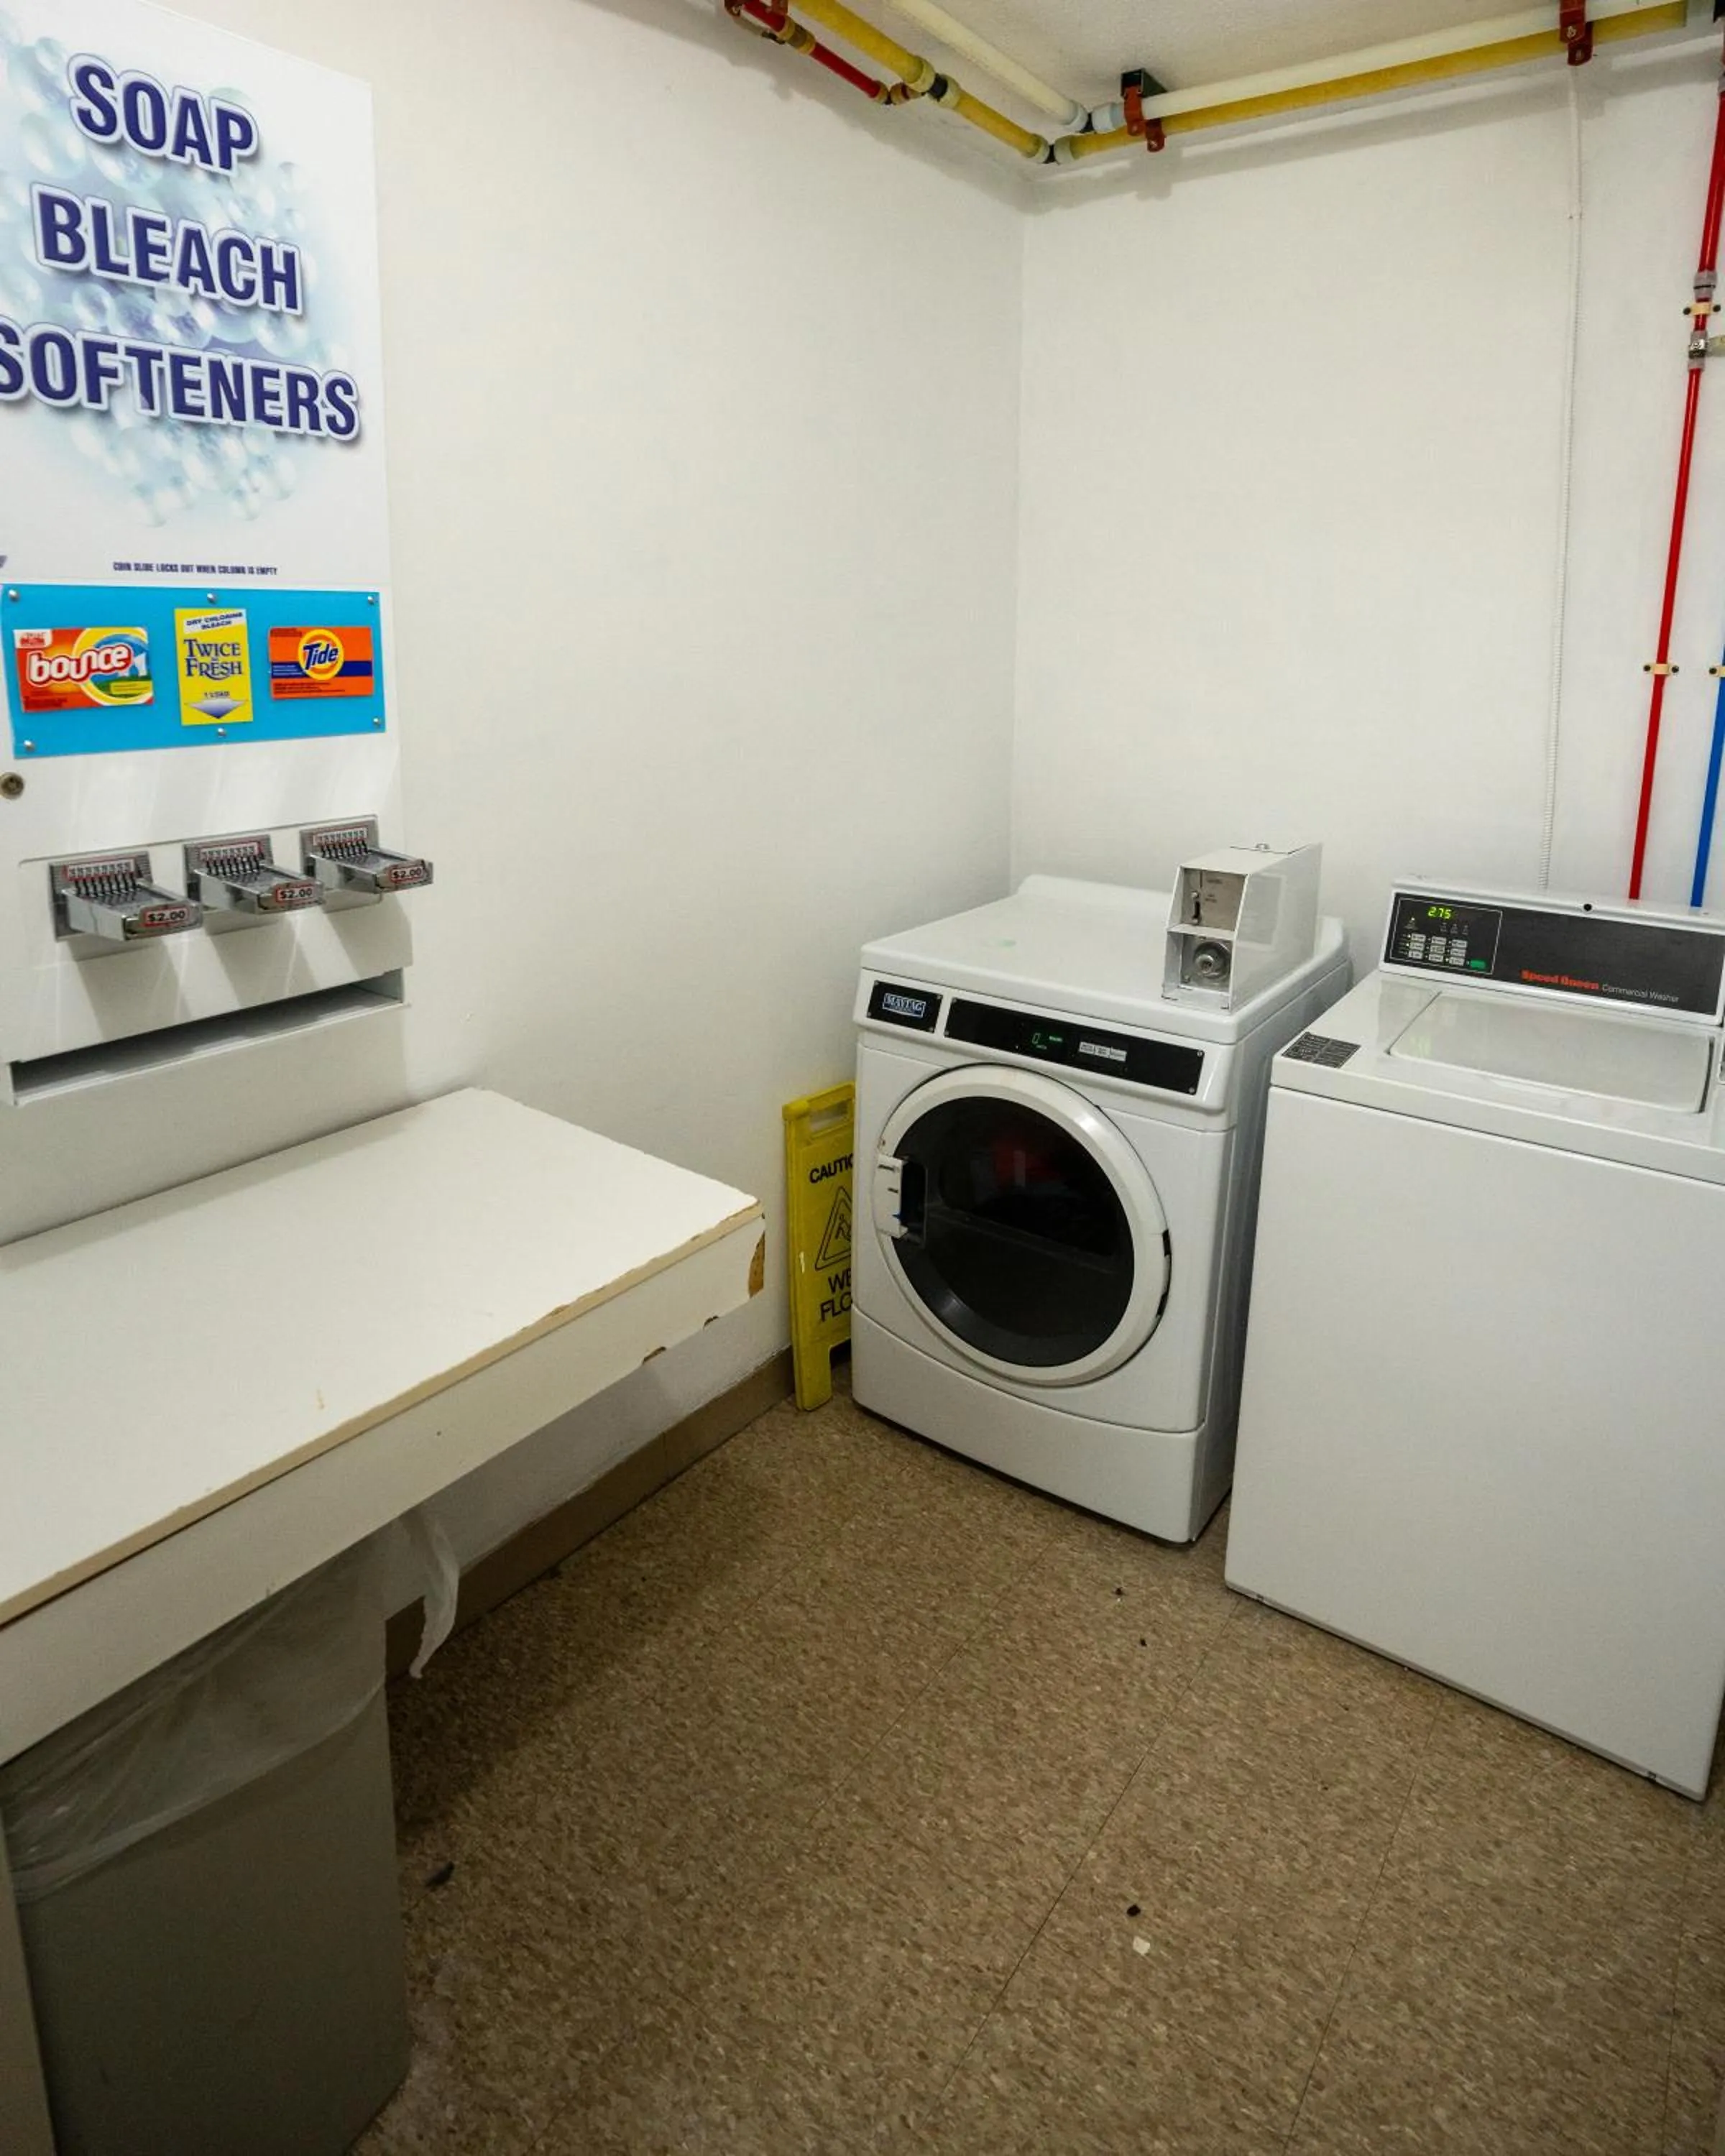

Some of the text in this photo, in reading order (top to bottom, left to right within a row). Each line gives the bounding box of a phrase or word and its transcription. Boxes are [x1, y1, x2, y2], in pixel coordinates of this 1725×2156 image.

[73, 62, 254, 172] SOAP
[37, 190, 299, 311] BLEACH
[0, 321, 357, 436] SOFTENERS
[113, 561, 278, 576] COIN SLIDE LOCKS OUT WHEN COLUMN IS EMPTY
[201, 620, 232, 630] BLEACH
[183, 638, 242, 658] TWICE
[303, 642, 339, 671] Tide
[29, 644, 130, 683] bounce
[185, 658, 244, 681] FRESH
[392, 868, 422, 880] $2.00
[280, 888, 313, 900] $2.00
[147, 910, 186, 923] $2.00
[1522, 970, 1680, 1003] Speed Queen Commercial Washer
[884, 994, 923, 1011] MAYTAG
[827, 1267, 852, 1294] WE
[819, 1291, 853, 1323] FLO
